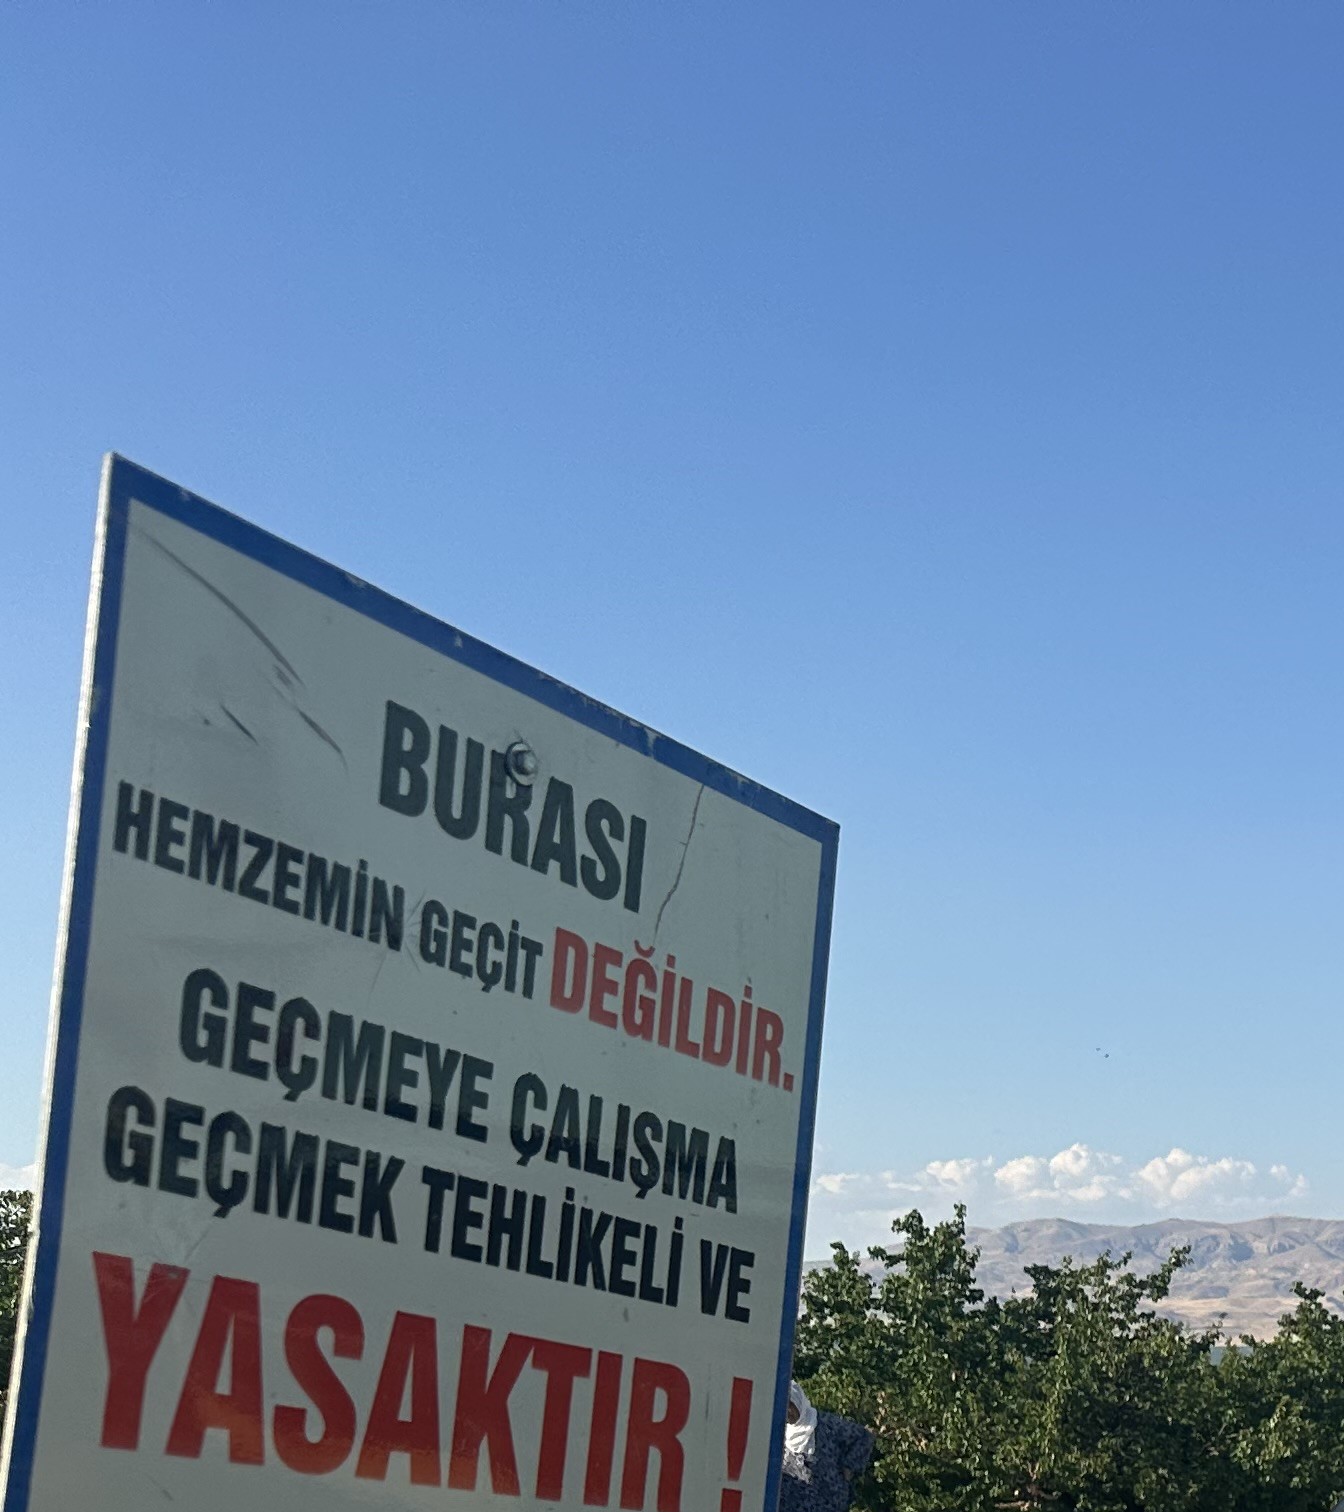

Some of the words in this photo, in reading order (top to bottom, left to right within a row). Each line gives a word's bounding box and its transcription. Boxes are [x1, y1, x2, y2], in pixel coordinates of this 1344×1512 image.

[378, 699, 647, 913] BURASI
[113, 778, 406, 952] HEMZEMİN
[419, 898, 543, 1001] GEÇİT
[551, 936, 795, 1093] DEĞİLDİR.
[104, 1085, 405, 1245] GEÇMEK
[422, 1165, 684, 1309] TEHLİKELİ
[700, 1239, 756, 1324] VE
[180, 966, 494, 1144] GEÇMEYE
[509, 1072, 739, 1215] ÇALIŞMA
